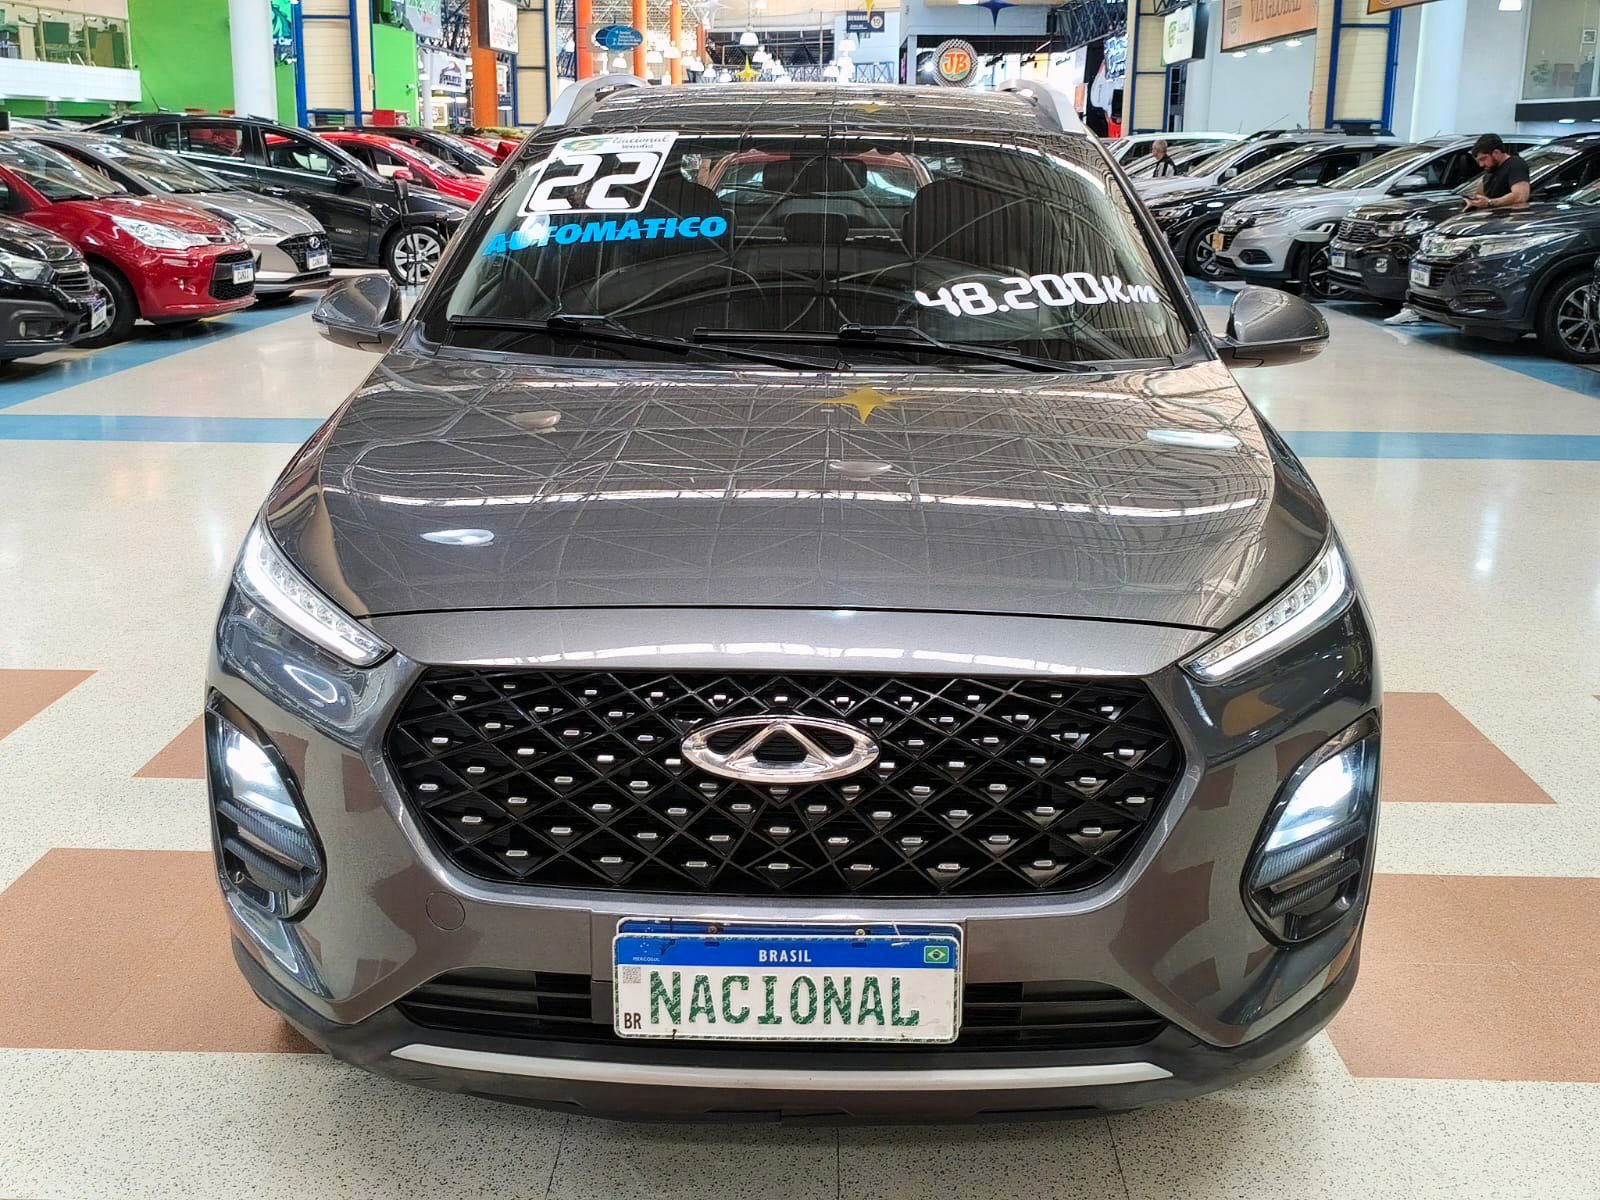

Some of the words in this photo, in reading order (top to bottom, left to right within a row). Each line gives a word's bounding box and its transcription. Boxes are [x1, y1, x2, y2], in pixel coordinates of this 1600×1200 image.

[944, 53, 969, 74] JB
[529, 152, 661, 212] 22
[758, 949, 812, 963] BRASIL
[650, 970, 920, 1027] NACIONAL
[624, 1012, 642, 1030] BR
